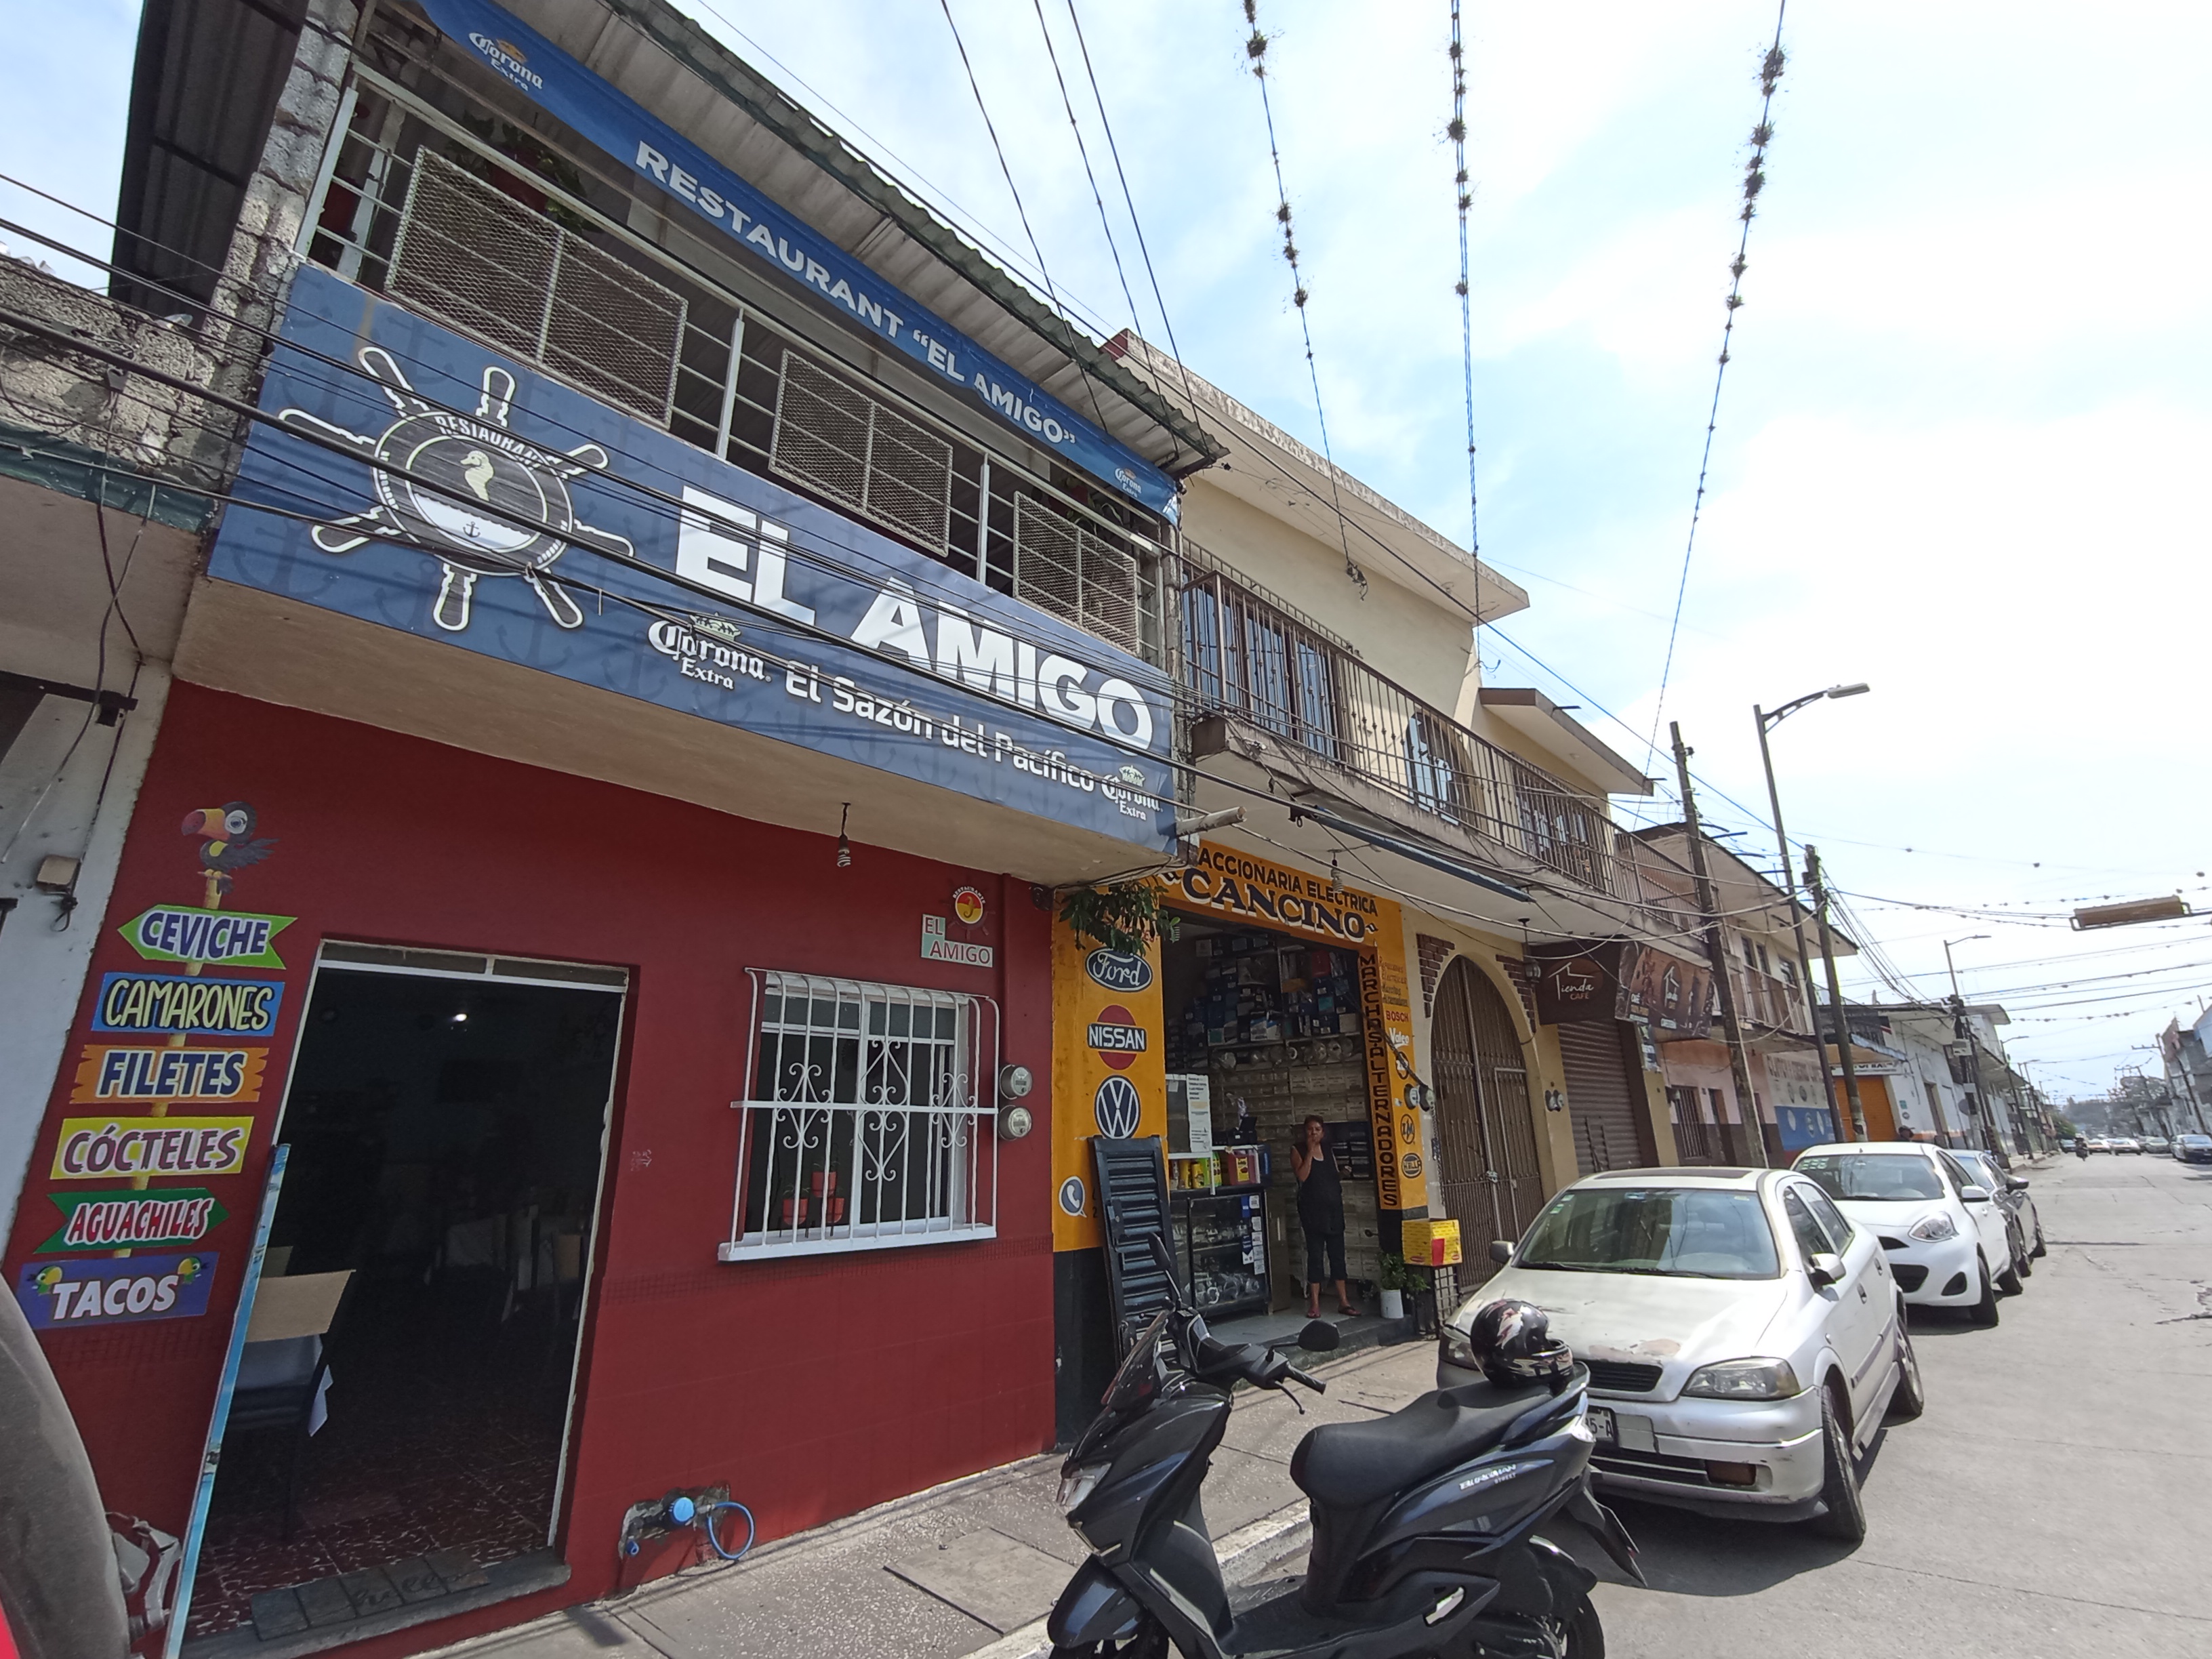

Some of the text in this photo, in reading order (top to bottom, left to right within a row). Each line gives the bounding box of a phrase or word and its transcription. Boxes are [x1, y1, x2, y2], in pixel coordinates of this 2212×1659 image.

[468, 33, 543, 89] Corona
[491, 58, 529, 91] Extra
[635, 140, 903, 338] RESTAURANT
[1115, 468, 1142, 493] Corona
[675, 485, 1153, 757] EL AMIGO
[647, 619, 767, 680] Corona
[680, 657, 735, 690] Extra
[785, 659, 1095, 792] El Sazón del Pacífico
[1119, 800, 1147, 821] Extra
[1197, 848, 1303, 894] ACCIONARIA
[140, 912, 271, 959] CEVICHE
[924, 917, 943, 936] EL
[929, 941, 991, 964] AMIGO
[1092, 951, 1141, 987] Ford
[103, 979, 274, 1031] CAMARONES
[1386, 1010, 1410, 1022] BOSCH
[1088, 1025, 1145, 1050] NISSAN
[1389, 1027, 1410, 1044] Valeo
[97, 1051, 246, 1099] FILETES
[62, 1125, 243, 1174] CÓCTELES
[64, 1197, 216, 1245] AGUACHILES
[53, 1274, 180, 1320] TACOS
